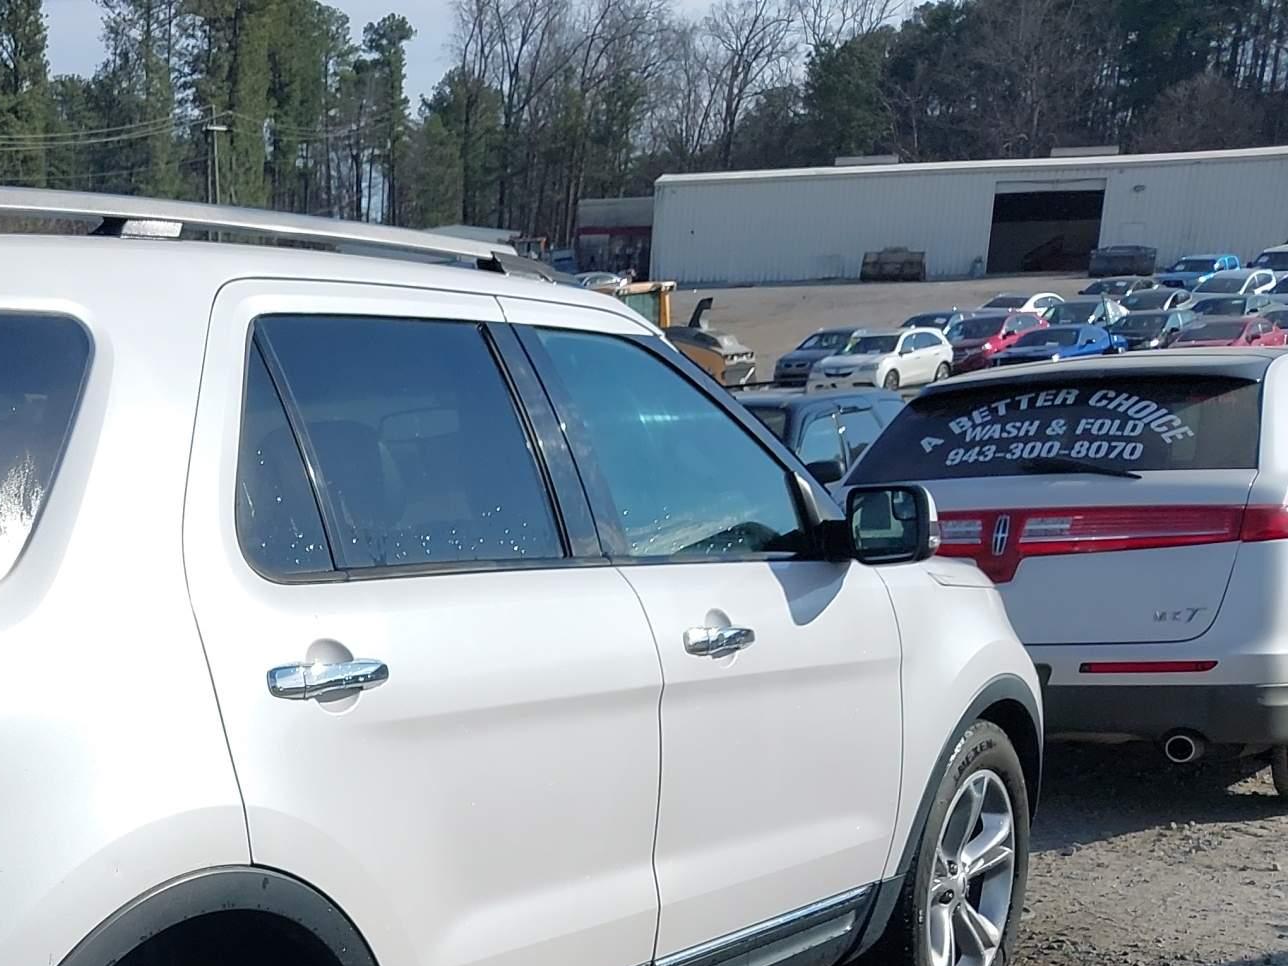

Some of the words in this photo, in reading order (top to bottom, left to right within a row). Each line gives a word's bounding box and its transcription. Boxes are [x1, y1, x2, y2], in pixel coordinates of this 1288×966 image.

[920, 434, 945, 453] A
[948, 388, 1080, 435] BETTER
[1088, 389, 1195, 444] CHOICE
[965, 420, 1040, 443] WASH
[1046, 418, 1067, 436] &
[1075, 418, 1145, 437] FOLD
[945, 441, 1144, 466] 943-300-8070
